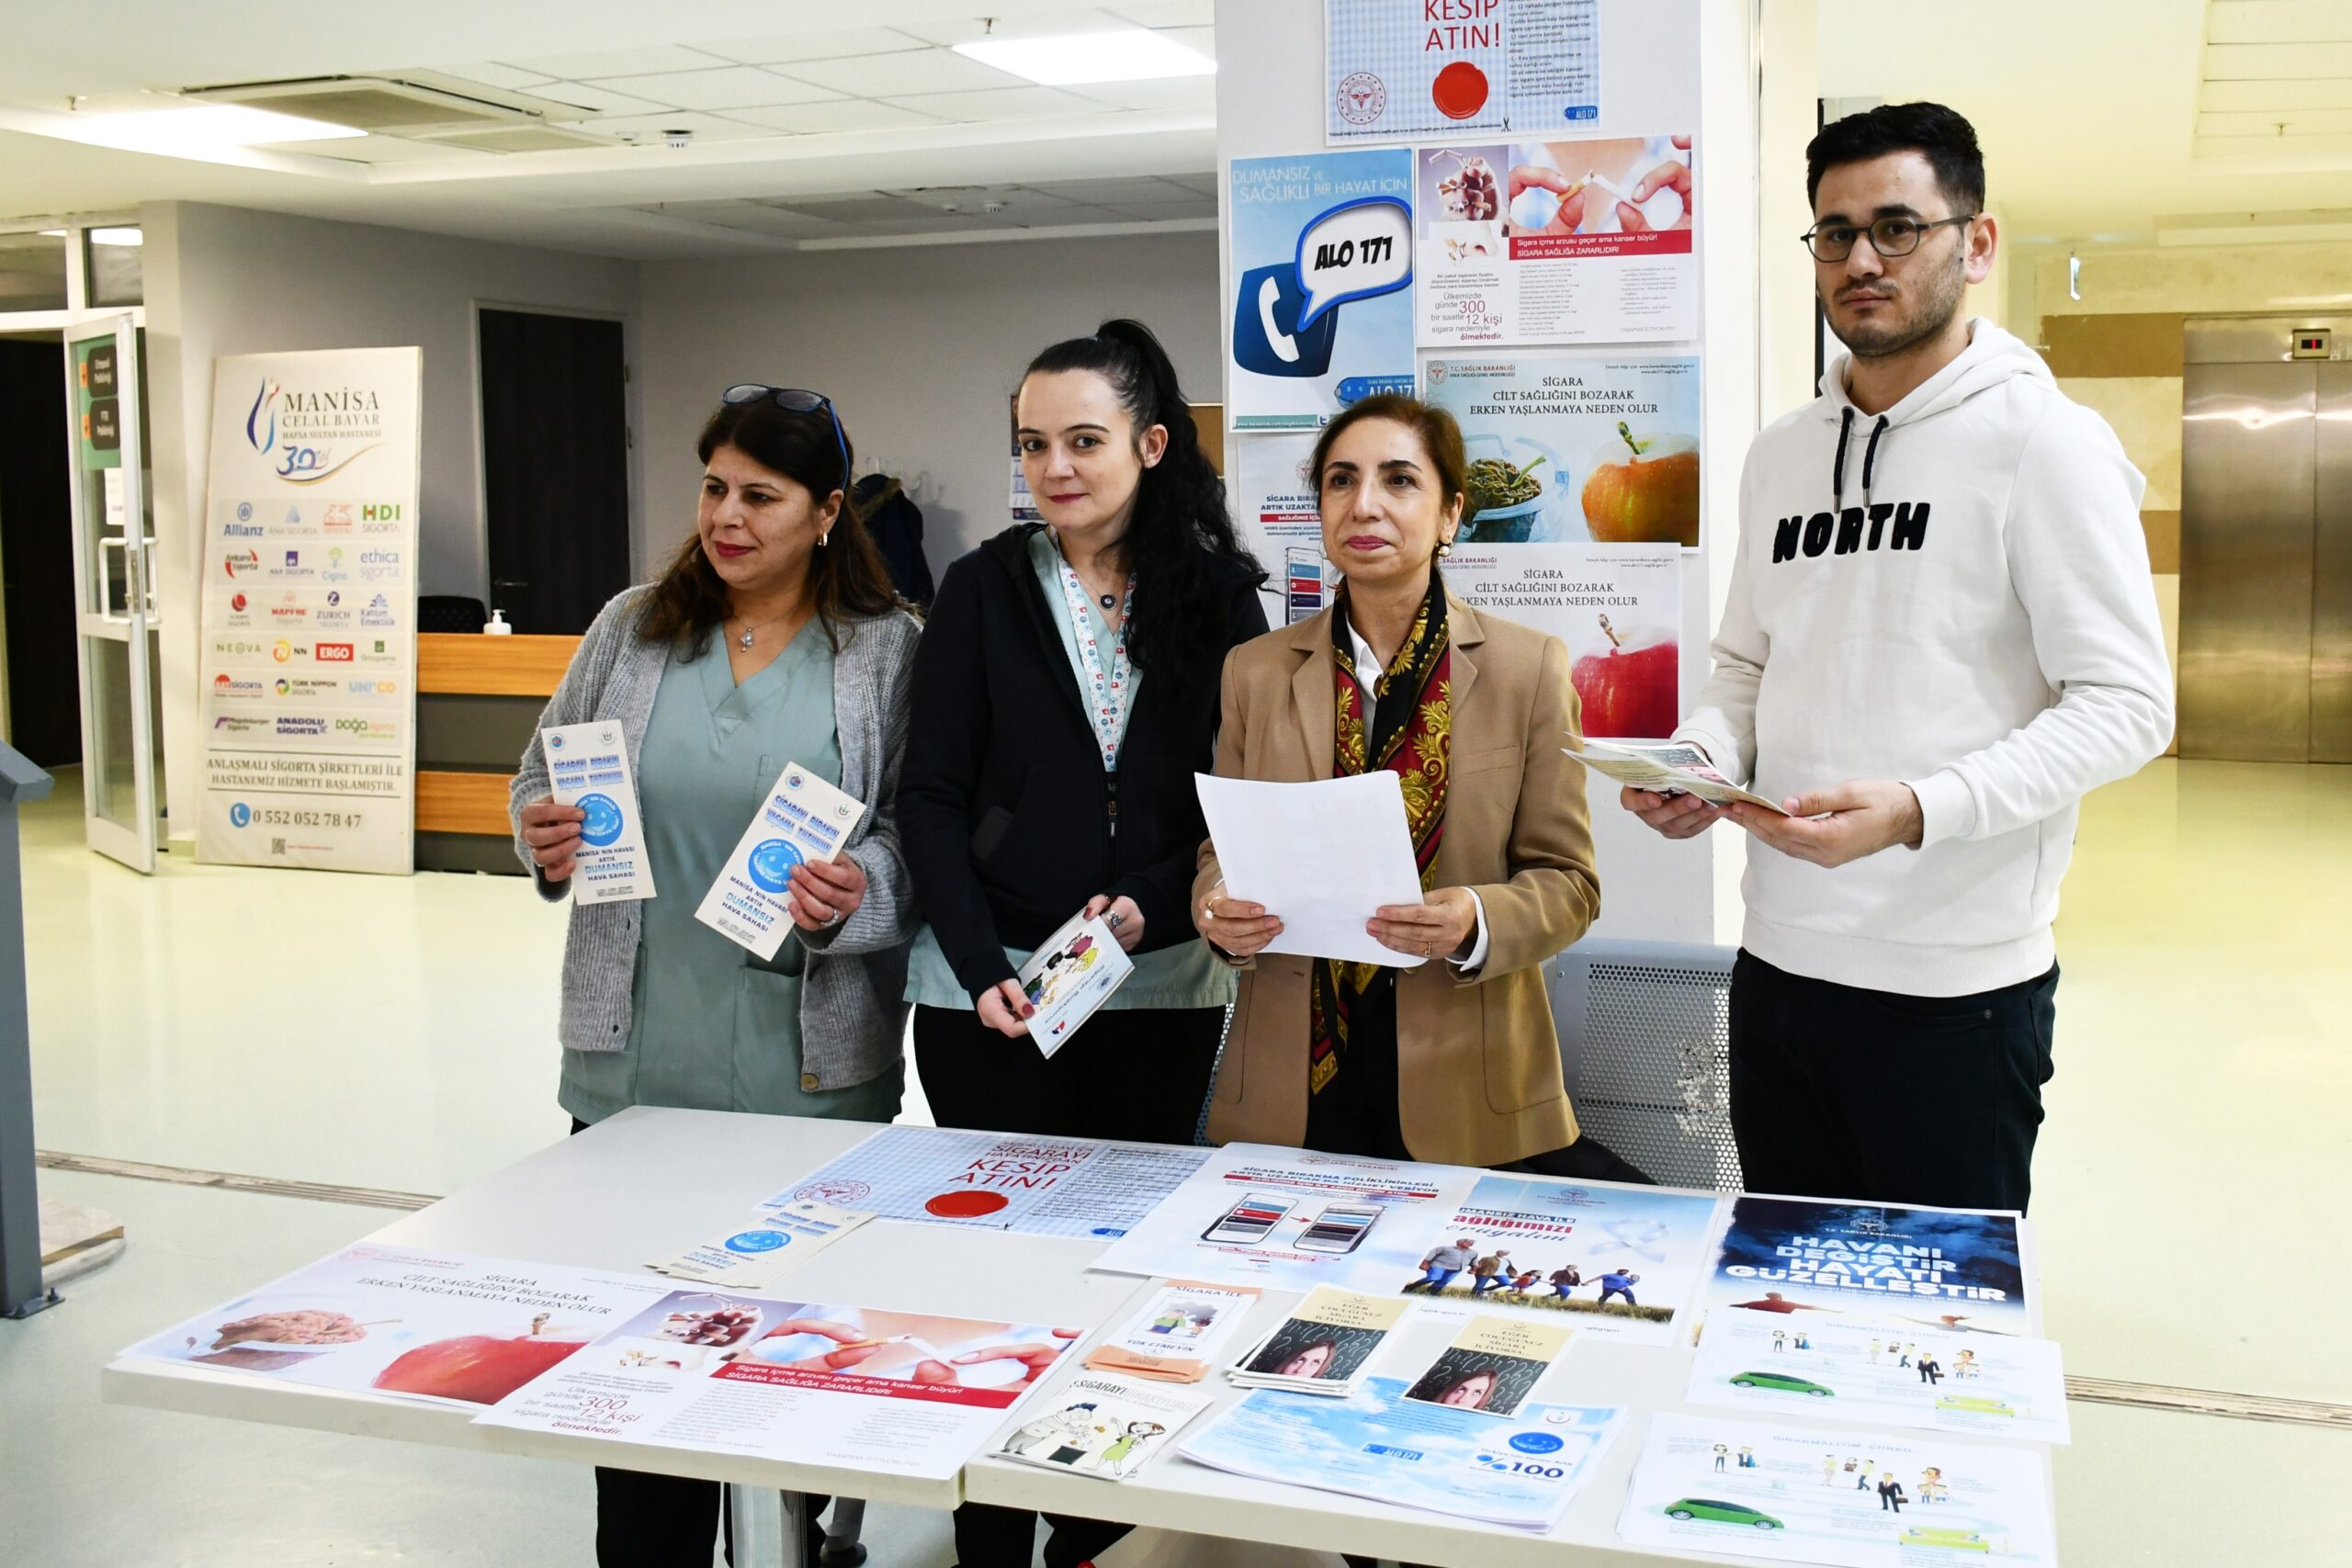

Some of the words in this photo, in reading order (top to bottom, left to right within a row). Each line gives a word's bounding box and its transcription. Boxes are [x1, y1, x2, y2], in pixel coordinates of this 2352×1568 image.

[1425, 23, 1499, 51] ATIN!
[1233, 166, 1310, 185] DUMANSIZ
[1240, 184, 1309, 203] SAĞLIKLI
[1335, 179, 1378, 195] HAYAT
[1614, 234, 1636, 243] kanser
[1314, 240, 1354, 271] ALO
[1360, 236, 1394, 265] 171
[1517, 248, 1543, 256] SİGARA
[1443, 291, 1482, 299] Ülkemizde
[1434, 301, 1458, 310] günde
[1459, 300, 1486, 313] 300
[1465, 313, 1479, 325] 12
[1483, 313, 1502, 326] kişi
[1455, 324, 1490, 333] nedeniyle
[1543, 375, 1583, 387] SİGARA
[284, 386, 379, 412] MANİSA
[1493, 389, 1517, 400] CİLT
[1520, 389, 1577, 401] SAĞLIĞINI
[1579, 389, 1634, 400] BOZARAK
[1470, 405, 1506, 415] ERKEN
[1510, 404, 1583, 417] YAŞLANMAYA
[1585, 404, 1625, 414] NEDEN
[1627, 403, 1659, 414] OLUR
[282, 414, 331, 427] CELAL
[334, 413, 380, 425] BAYAR
[363, 504, 401, 521] HDI
[223, 525, 264, 536] Allianz
[1772, 502, 1930, 564] NORTH
[360, 549, 399, 564] ethica
[1523, 569, 1564, 579] SİGARA
[1476, 582, 1498, 592] CİLT
[1501, 581, 1556, 592] SAĞLIĞINI
[1560, 583, 1614, 592] BOZARAK
[1492, 596, 1562, 608] YAŞLANMAYA
[1566, 596, 1605, 606] NEDEN
[1608, 596, 1638, 606] OLUR
[316, 610, 350, 619] ZURICH
[320, 647, 349, 660] ERGO
[277, 716, 324, 726] ANADOLU
[207, 758, 268, 772] ANLAŞMALI
[273, 760, 317, 773] SİGORTA
[319, 761, 383, 775] ŞİRKETLERİ
[386, 763, 402, 776] İLE
[211, 773, 276, 787] HASTANEMİZ
[277, 774, 322, 788] HİZMETE
[253, 810, 261, 823] 0
[265, 810, 289, 825] 552
[294, 812, 320, 826] 052
[323, 814, 341, 826] 78
[344, 814, 362, 827] 47
[584, 861, 633, 874] DUMANSIZ
[587, 874, 607, 882] HAVA
[608, 872, 635, 880] SAHASI
[725, 891, 775, 926] DUMANSIZ
[745, 895, 763, 908] ARTIK
[721, 901, 741, 916] HAVA
[741, 913, 769, 932] SAHASI
[948, 1172, 1057, 1190] ATIN!
[1518, 1213, 1553, 1222] HAVA
[1792, 1235, 1941, 1258] HAVANI
[1790, 1258, 1941, 1283] HAYATI
[482, 1274, 537, 1287] SİGARA
[357, 1277, 404, 1289] ERKEN
[410, 1283, 508, 1303] YAŞLANMAYA
[512, 1296, 568, 1309] NEDEN
[566, 1303, 612, 1315] OLUR
[517, 1288, 594, 1303] BOZARAK
[865, 1378, 889, 1386] ama
[889, 1380, 928, 1391] kanser
[543, 1390, 583, 1401] günde
[579, 1395, 628, 1410] 300
[579, 1408, 605, 1418] 12
[608, 1410, 644, 1424] kişi
